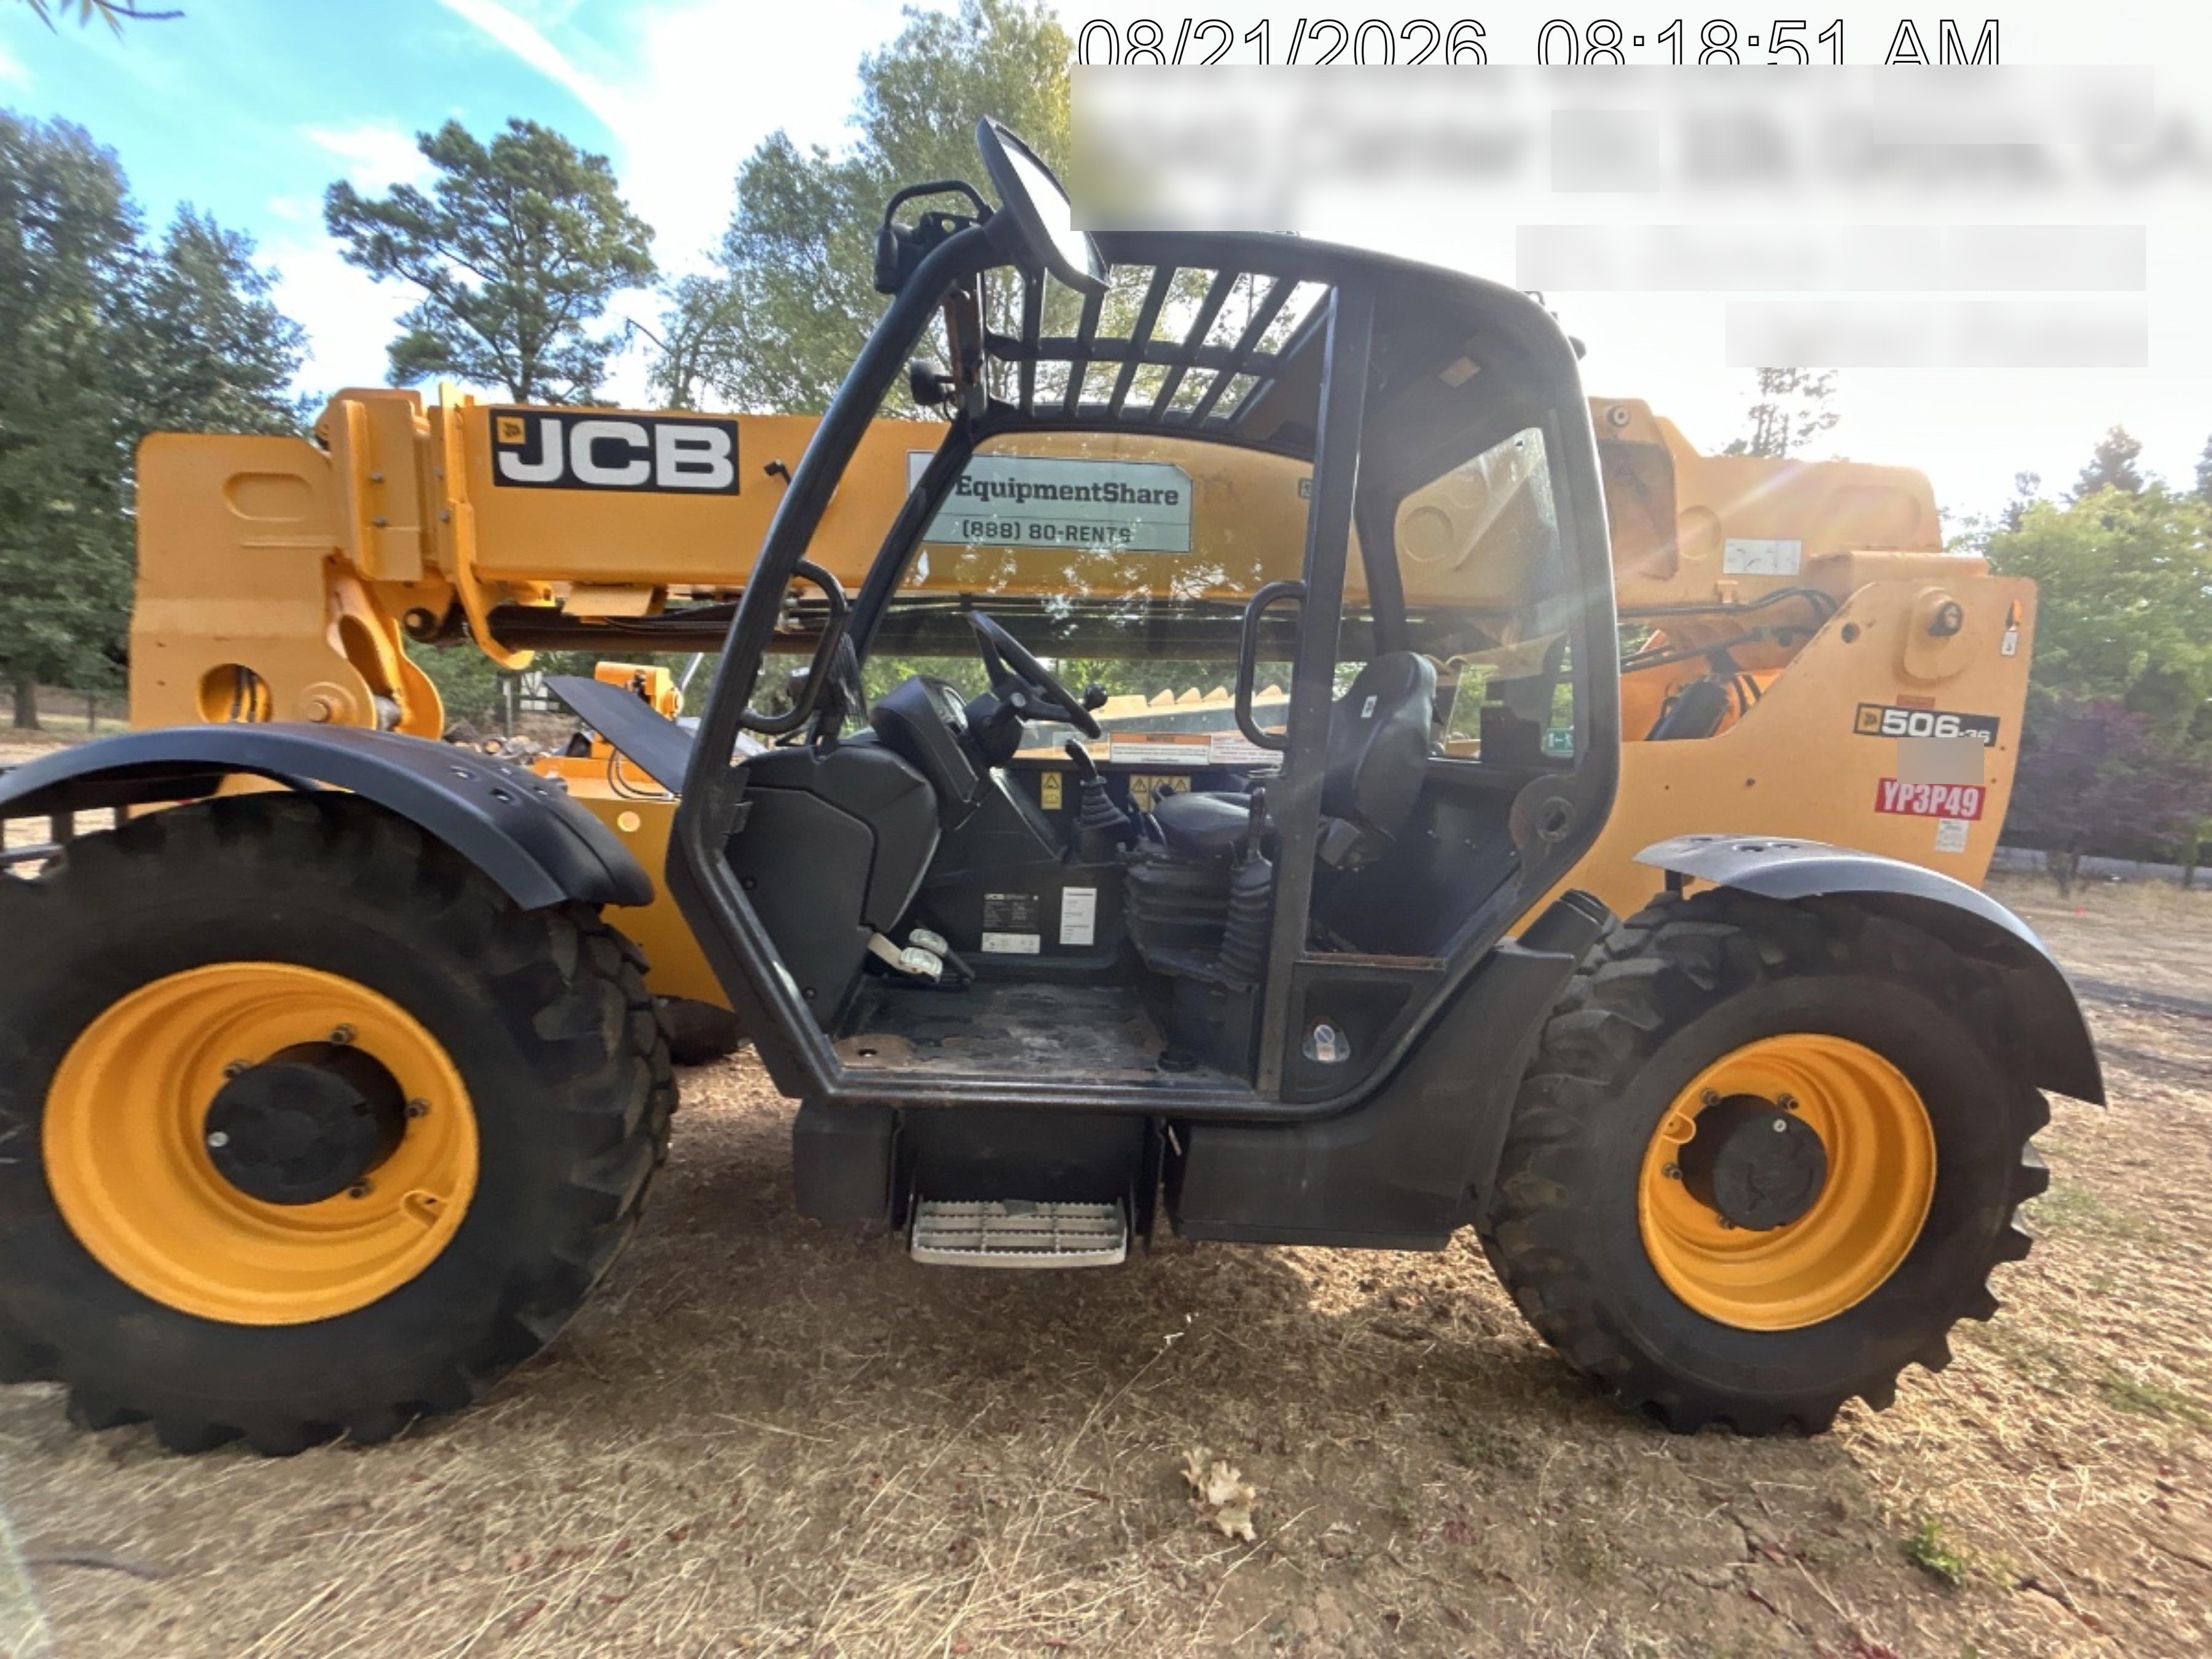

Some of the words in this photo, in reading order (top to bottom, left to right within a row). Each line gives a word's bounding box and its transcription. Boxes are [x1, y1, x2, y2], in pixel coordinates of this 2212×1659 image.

[498, 418, 734, 488] JCB
[955, 476, 1179, 506] EquipmentShare
[962, 519, 1021, 540] (888)
[1883, 781, 1979, 817] YP3P49
